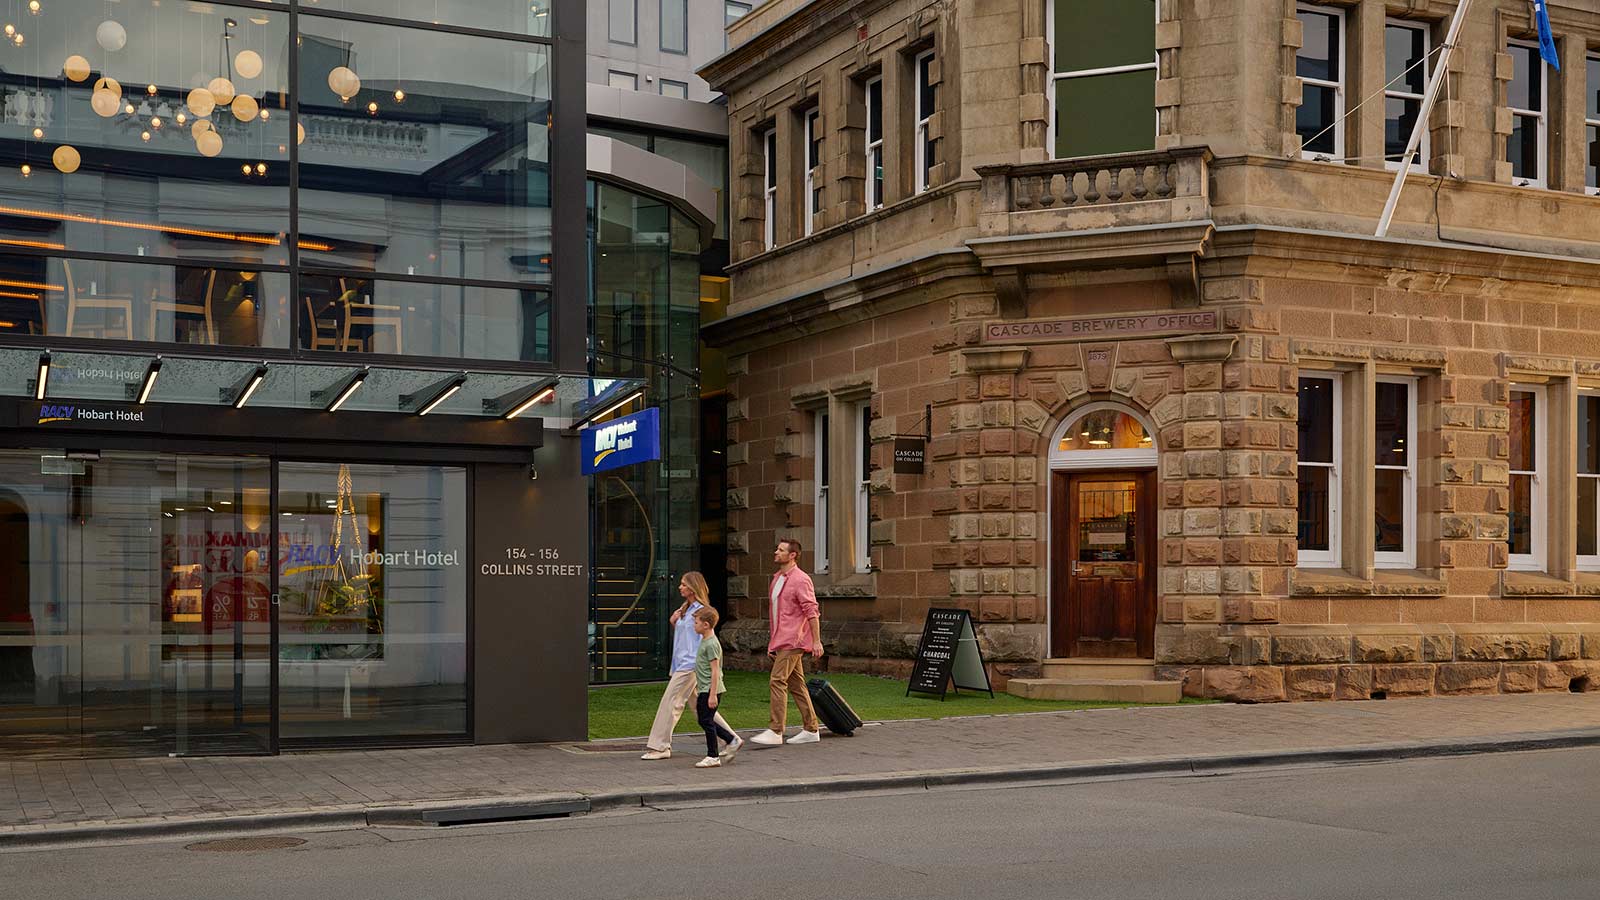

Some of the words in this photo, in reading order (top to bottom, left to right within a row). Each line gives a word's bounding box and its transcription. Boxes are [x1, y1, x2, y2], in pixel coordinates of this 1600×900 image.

[990, 323, 1063, 337] CASCADE
[1072, 317, 1149, 332] BREWERY
[1157, 314, 1213, 328] OFFICE
[1088, 352, 1107, 361] 1879
[40, 405, 75, 417] RACV
[77, 409, 114, 420] Hobart
[116, 410, 144, 421] Hotel
[286, 544, 344, 564] RACV
[350, 549, 410, 566] Hobart
[414, 549, 460, 566] Hotel
[505, 548, 526, 560] 154
[538, 548, 559, 560] 156
[481, 564, 534, 576] COLLINS
[536, 564, 583, 576] STREET
